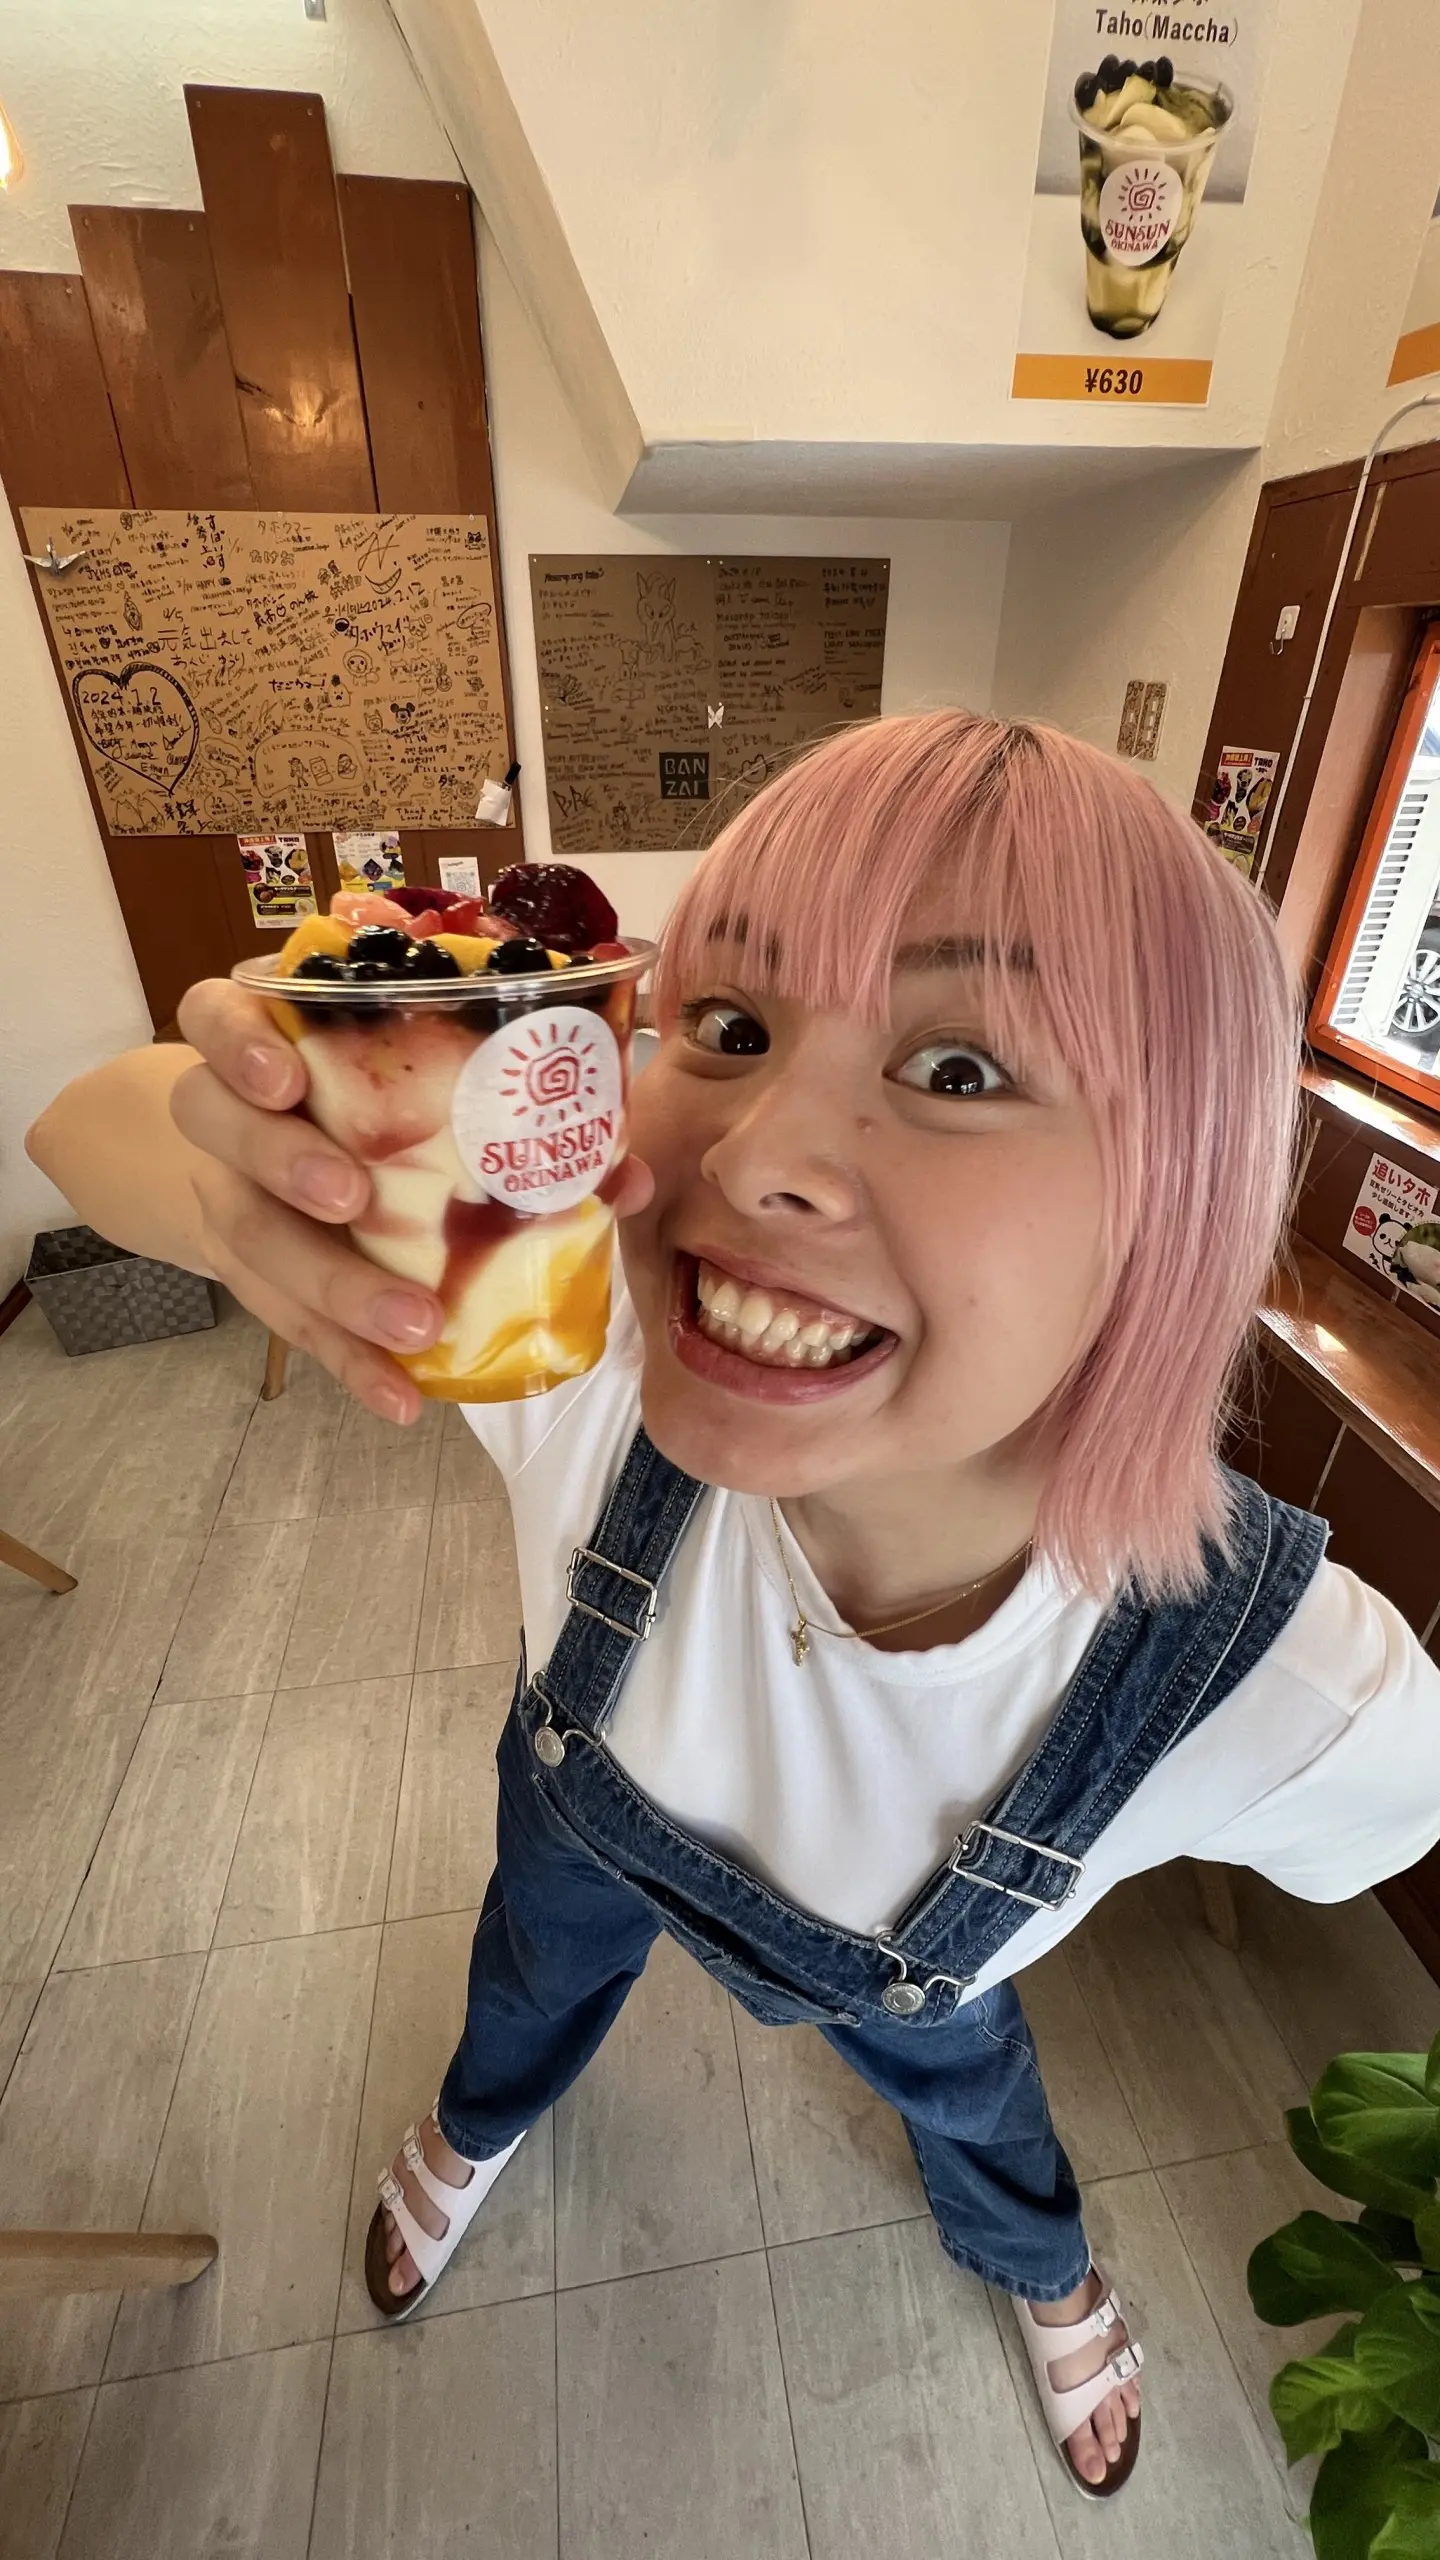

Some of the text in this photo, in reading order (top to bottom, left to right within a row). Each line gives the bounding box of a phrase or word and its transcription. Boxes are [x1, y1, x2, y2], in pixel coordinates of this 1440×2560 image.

[1105, 219, 1171, 243] SUNSUN
[1110, 239, 1159, 254] OKINAWA
[1084, 368, 1144, 395] ¥630
[664, 758, 707, 775] BAN
[665, 780, 700, 796] ZAI
[480, 1110, 613, 1174] SUNSUN
[503, 1150, 604, 1193] OKINAWA
[1371, 1159, 1432, 1207] 追いタホ
